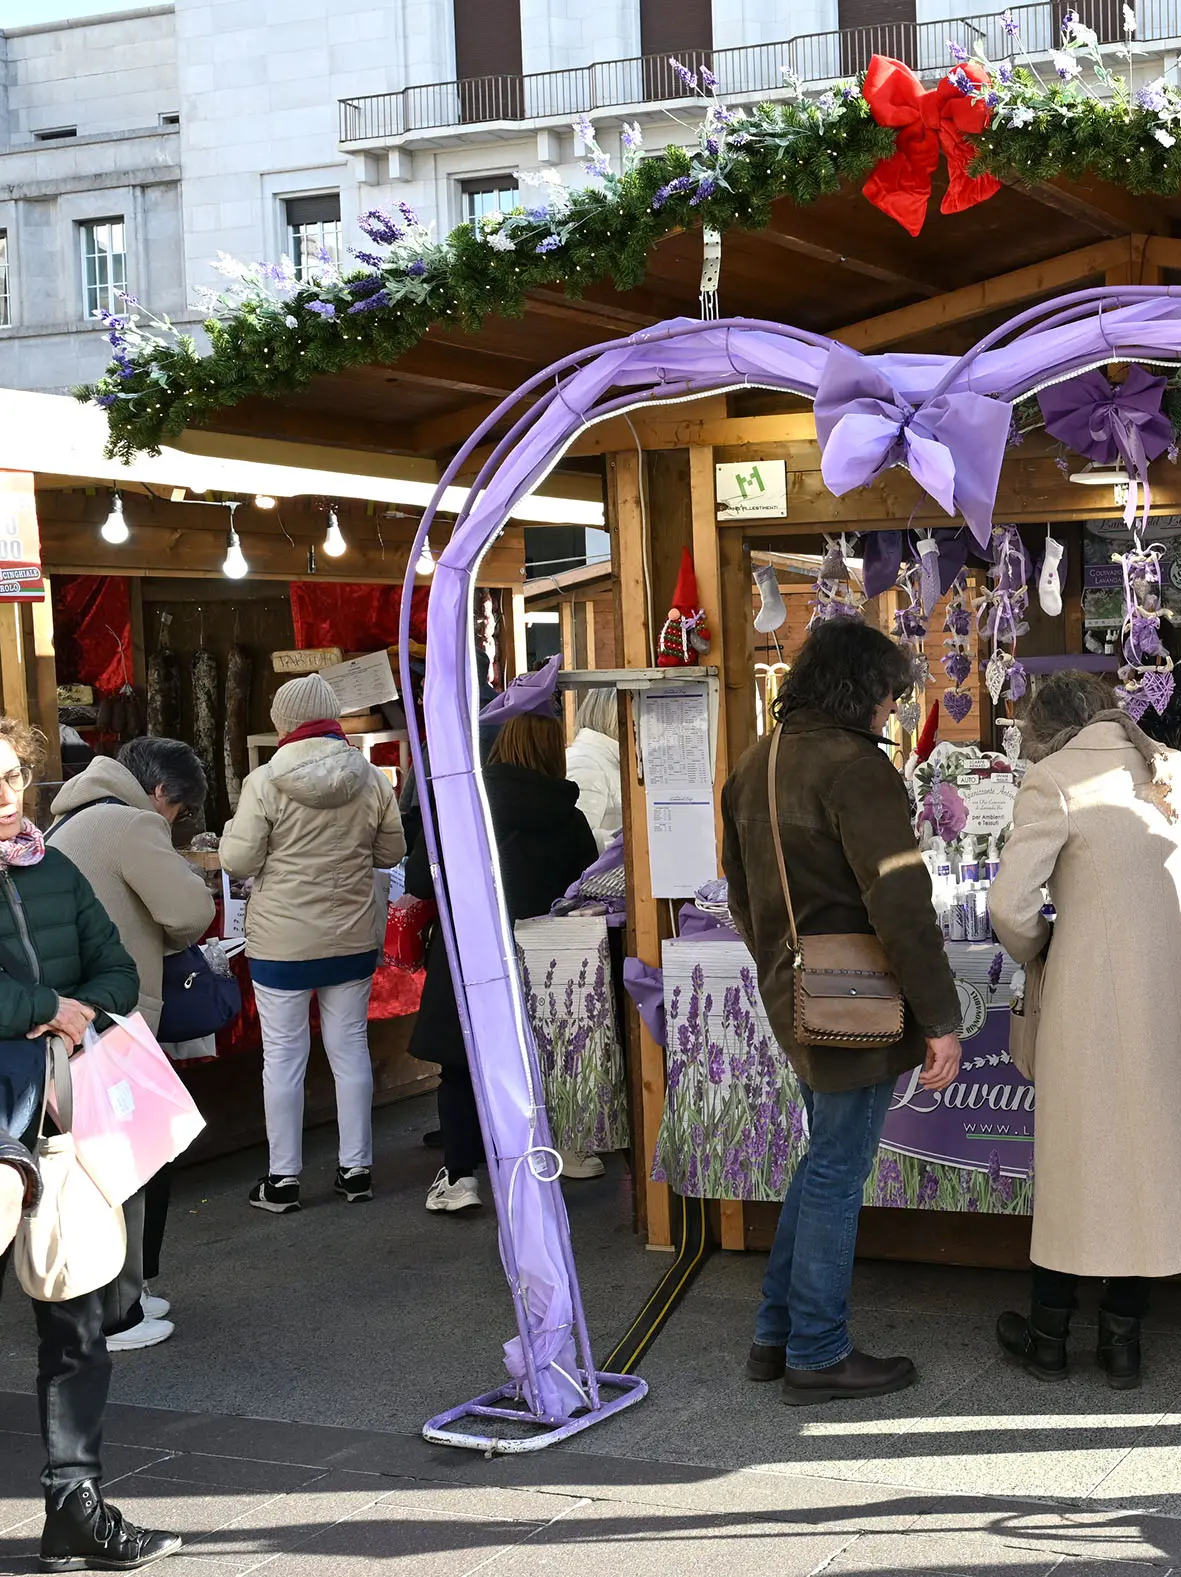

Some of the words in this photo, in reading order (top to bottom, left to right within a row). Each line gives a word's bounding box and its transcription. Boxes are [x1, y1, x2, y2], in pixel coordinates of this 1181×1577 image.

[2, 569, 38, 580] CINGHIALE
[966, 990, 982, 1034] RINNOVABILI
[888, 1064, 1035, 1113] Lavan
[964, 1122, 1034, 1135] WWW.L
